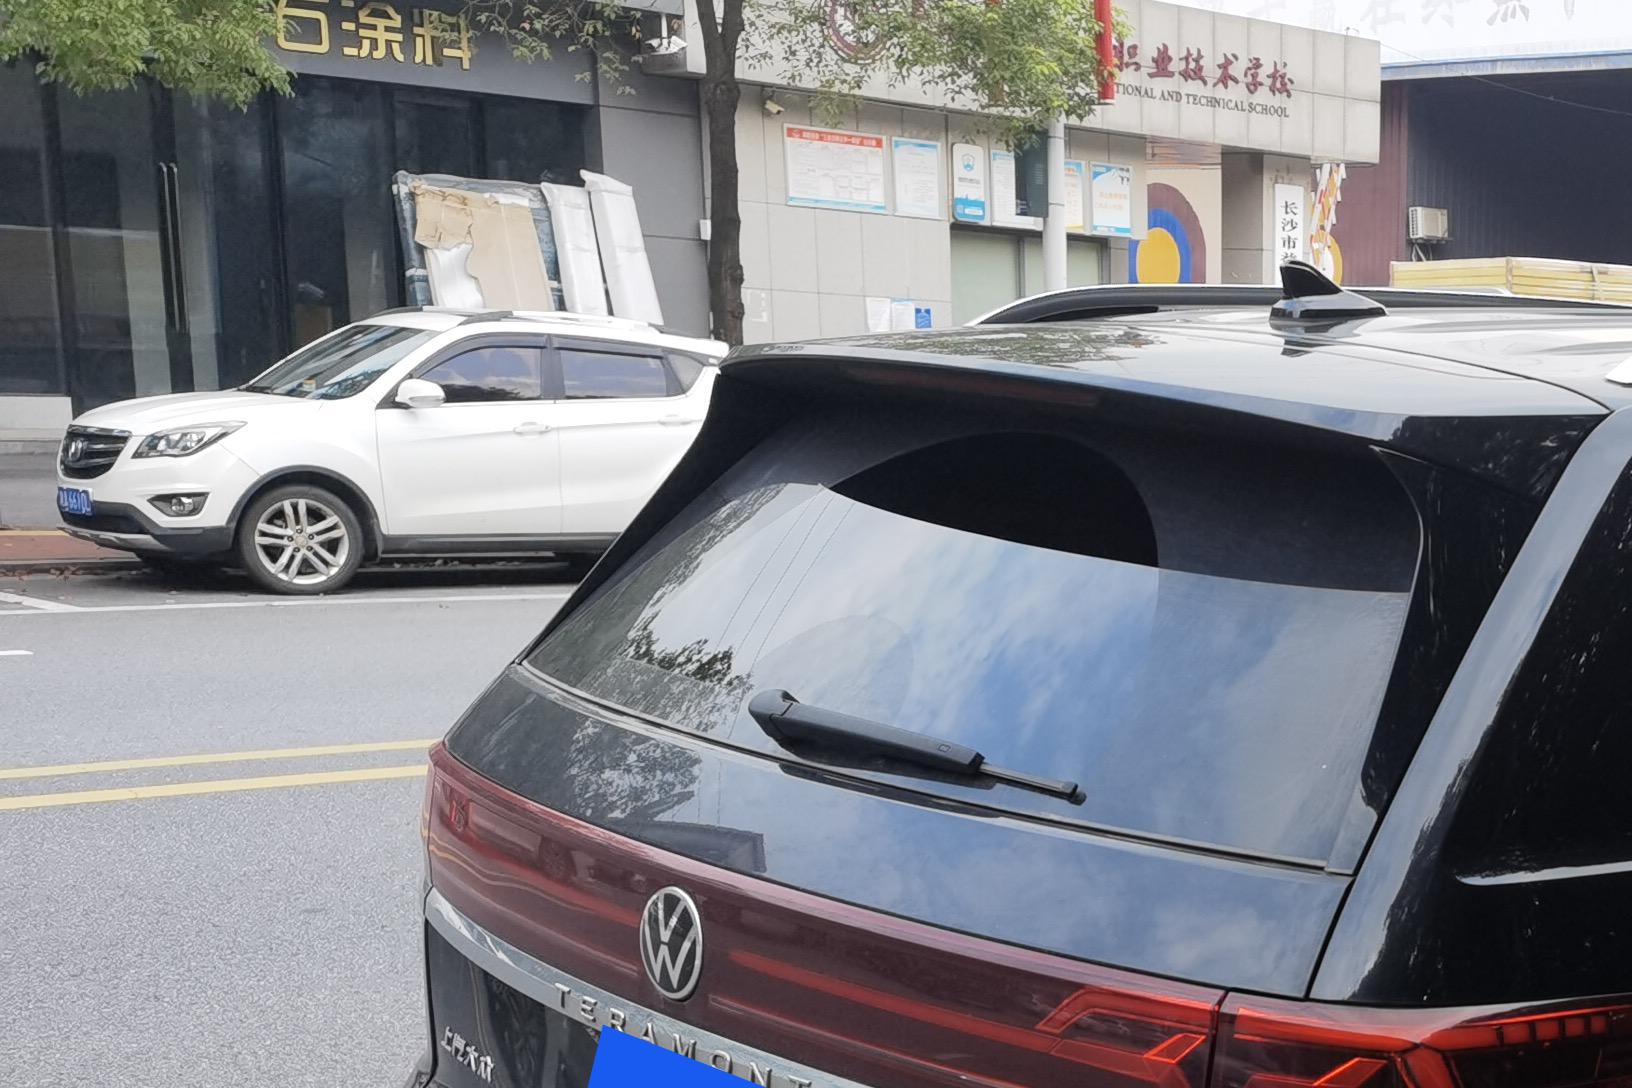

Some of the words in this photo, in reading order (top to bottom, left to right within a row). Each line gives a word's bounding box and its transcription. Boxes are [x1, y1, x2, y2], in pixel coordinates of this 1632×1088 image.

[1112, 39, 1295, 98] 职业技术学校
[1115, 82, 1156, 99] TIONAL
[1159, 89, 1182, 103] AND
[1185, 93, 1247, 113] TECHNICAL
[1247, 102, 1290, 118] SCHOOL
[440, 1026, 495, 1083] 上汽大众
